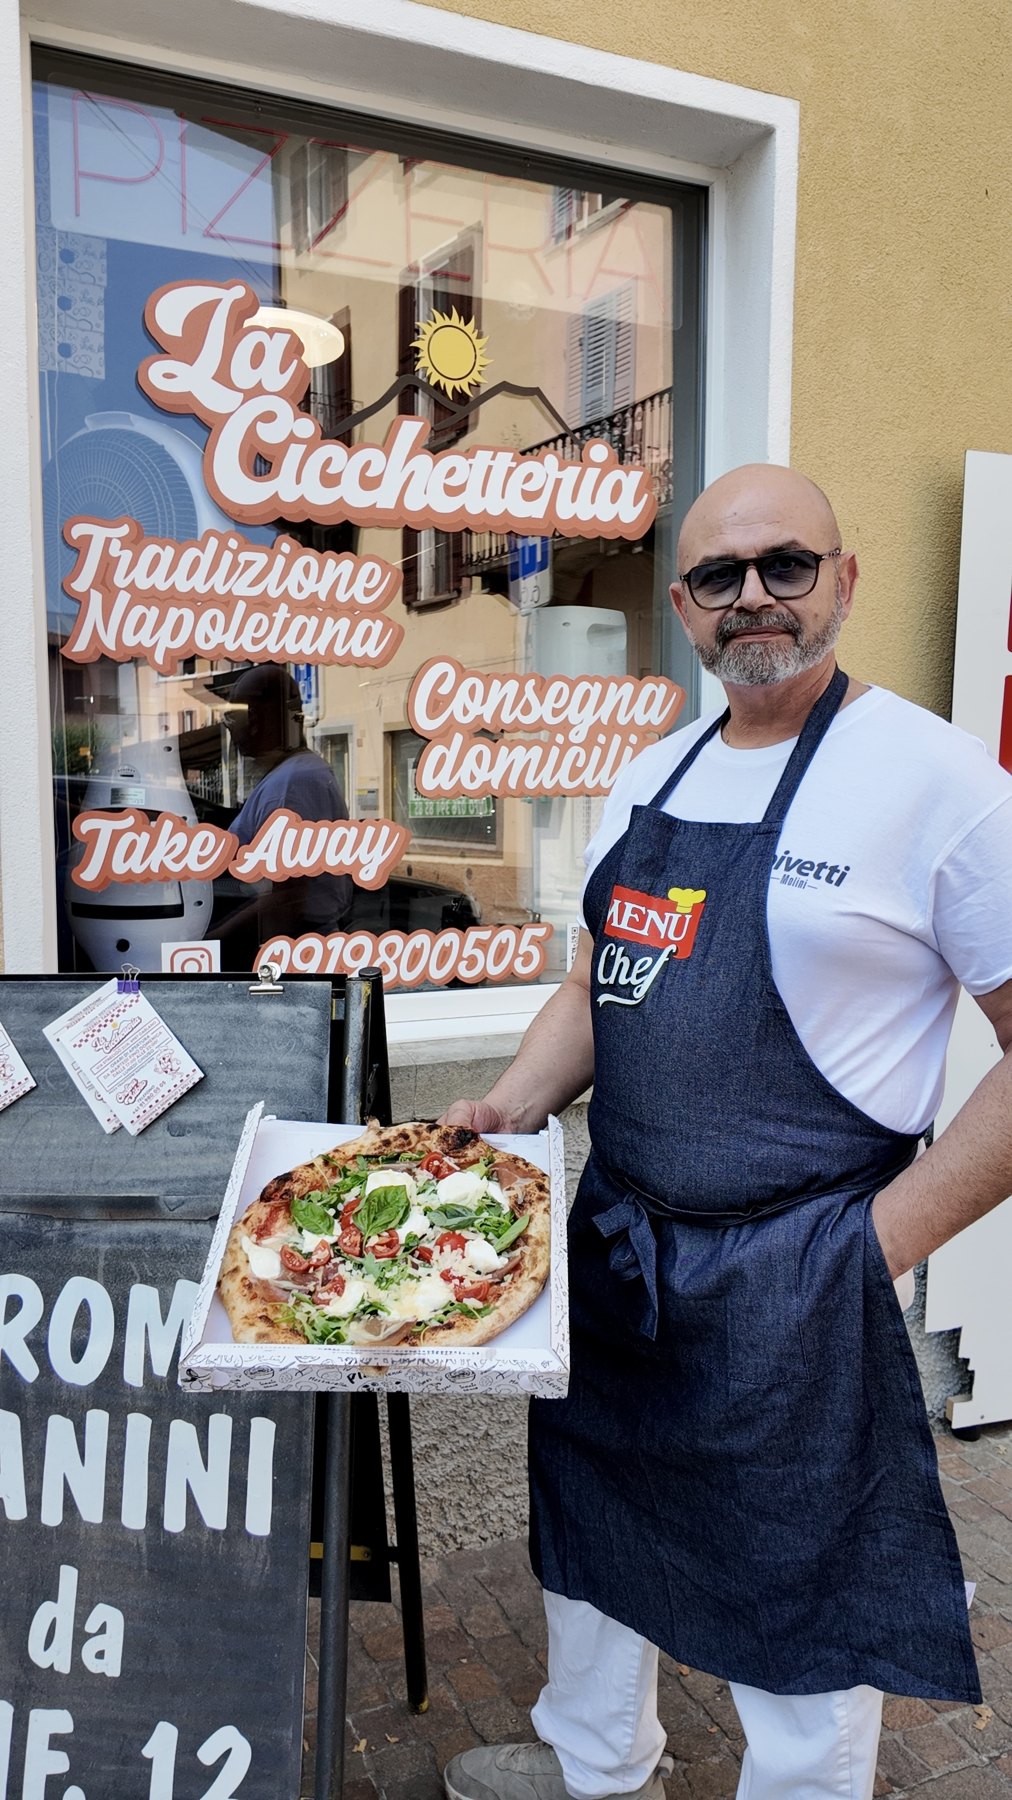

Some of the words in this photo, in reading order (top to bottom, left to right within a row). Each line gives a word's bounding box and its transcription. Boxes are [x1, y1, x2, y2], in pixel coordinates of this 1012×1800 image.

[72, 91, 666, 316] PIZZERIA
[148, 285, 298, 413] La
[213, 395, 649, 524] Cicchetteria
[71, 523, 391, 604] Tradizione
[72, 588, 392, 665] Napoletana
[414, 662, 676, 743] Consegna
[79, 815, 225, 881] Take
[236, 816, 399, 881] Away
[781, 874, 808, 889] Molini
[258, 927, 546, 983] 0919800505
[598, 943, 677, 1000] Chef
[28, 1565, 125, 1678] da
[141, 1720, 252, 1800] 12
